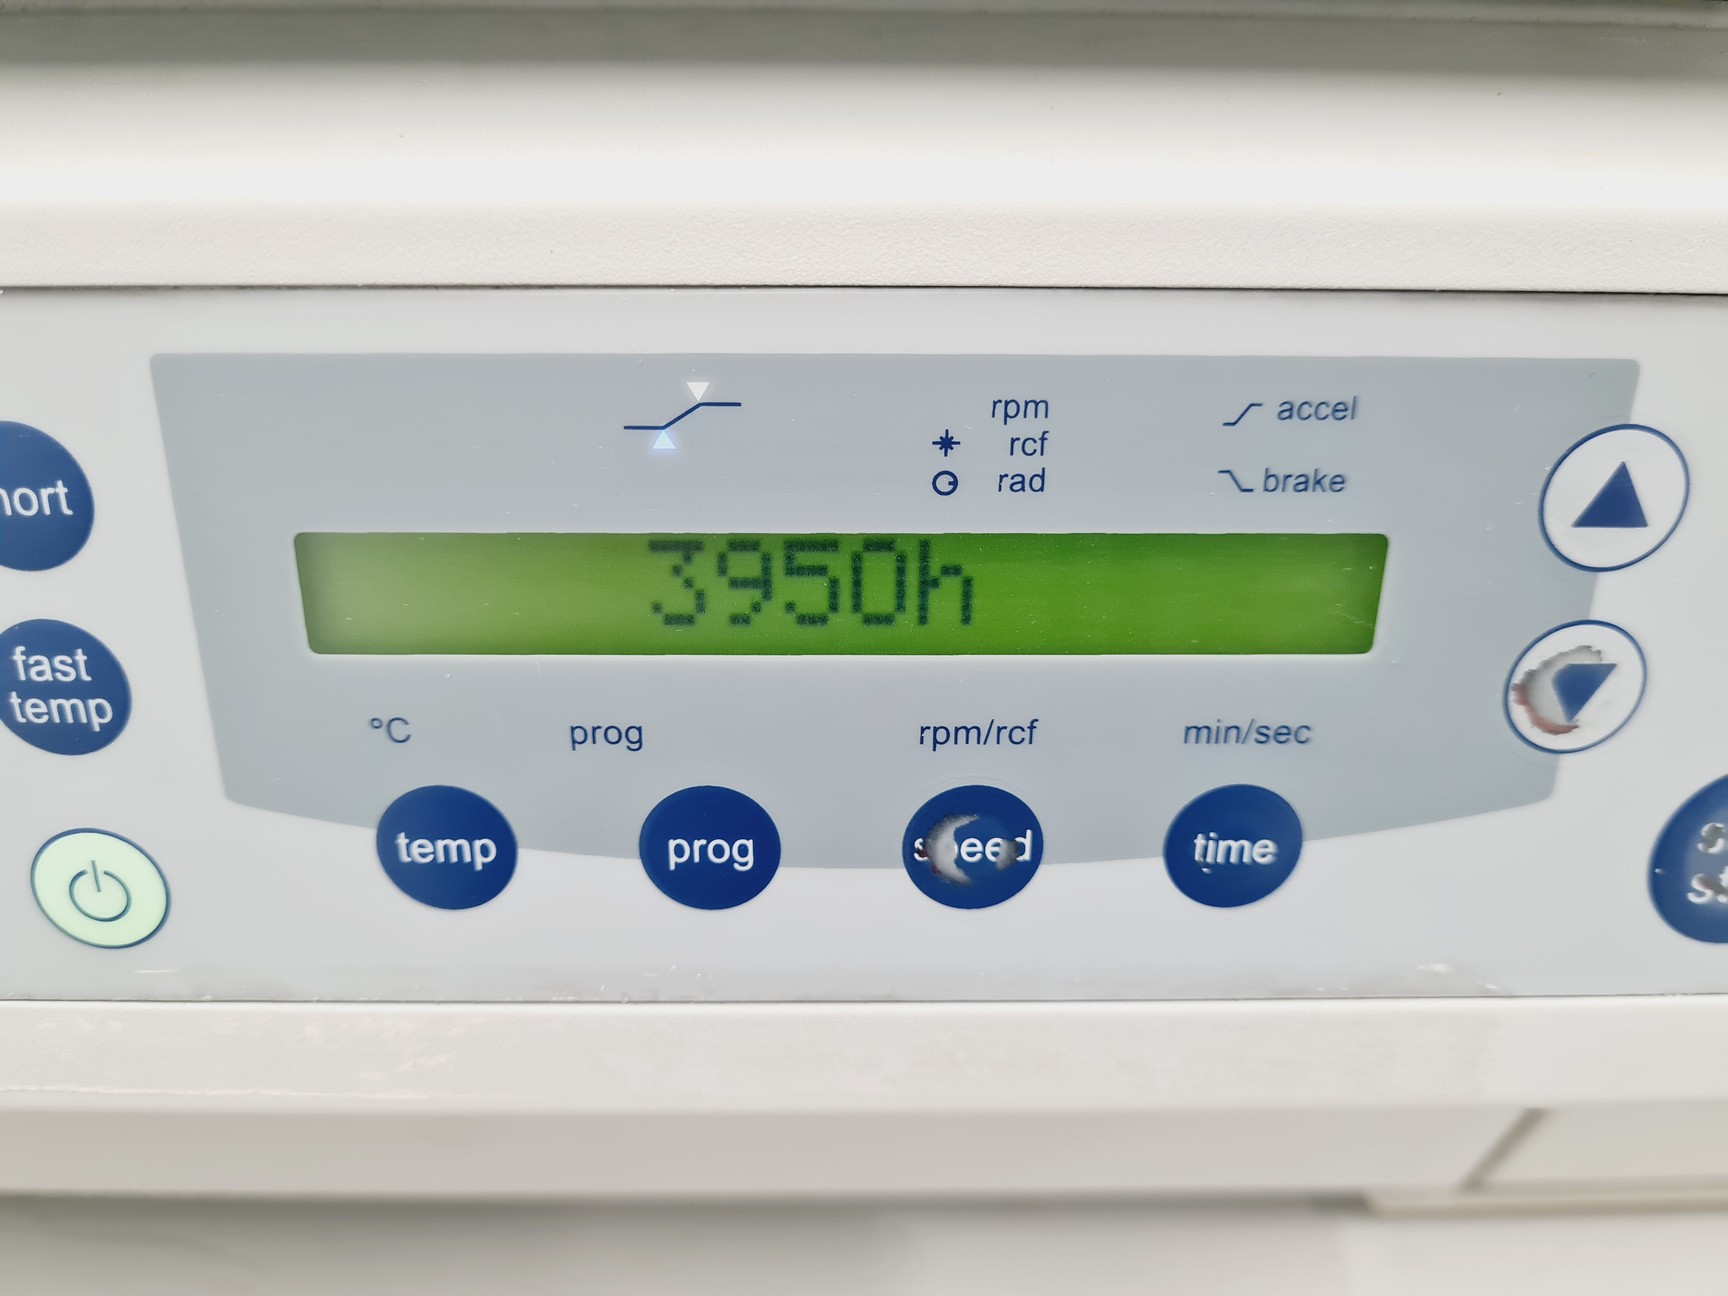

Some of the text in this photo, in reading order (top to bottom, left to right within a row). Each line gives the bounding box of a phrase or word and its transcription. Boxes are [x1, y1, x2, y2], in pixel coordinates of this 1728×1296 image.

[991, 399, 1049, 421] rpm
[1277, 396, 1358, 421] accel
[1009, 430, 1050, 457] rcf
[997, 467, 1046, 493] rad
[1263, 468, 1347, 493] brake
[648, 539, 973, 626] 3950h
[12, 645, 92, 682] fast
[9, 691, 113, 731] temp
[569, 722, 643, 752] prog
[918, 718, 1039, 752] rpm/rcf
[1183, 718, 1314, 746] min/sec
[396, 831, 497, 871] temp
[667, 836, 754, 872] prog
[913, 829, 1032, 862] seed
[1193, 832, 1278, 866] time
